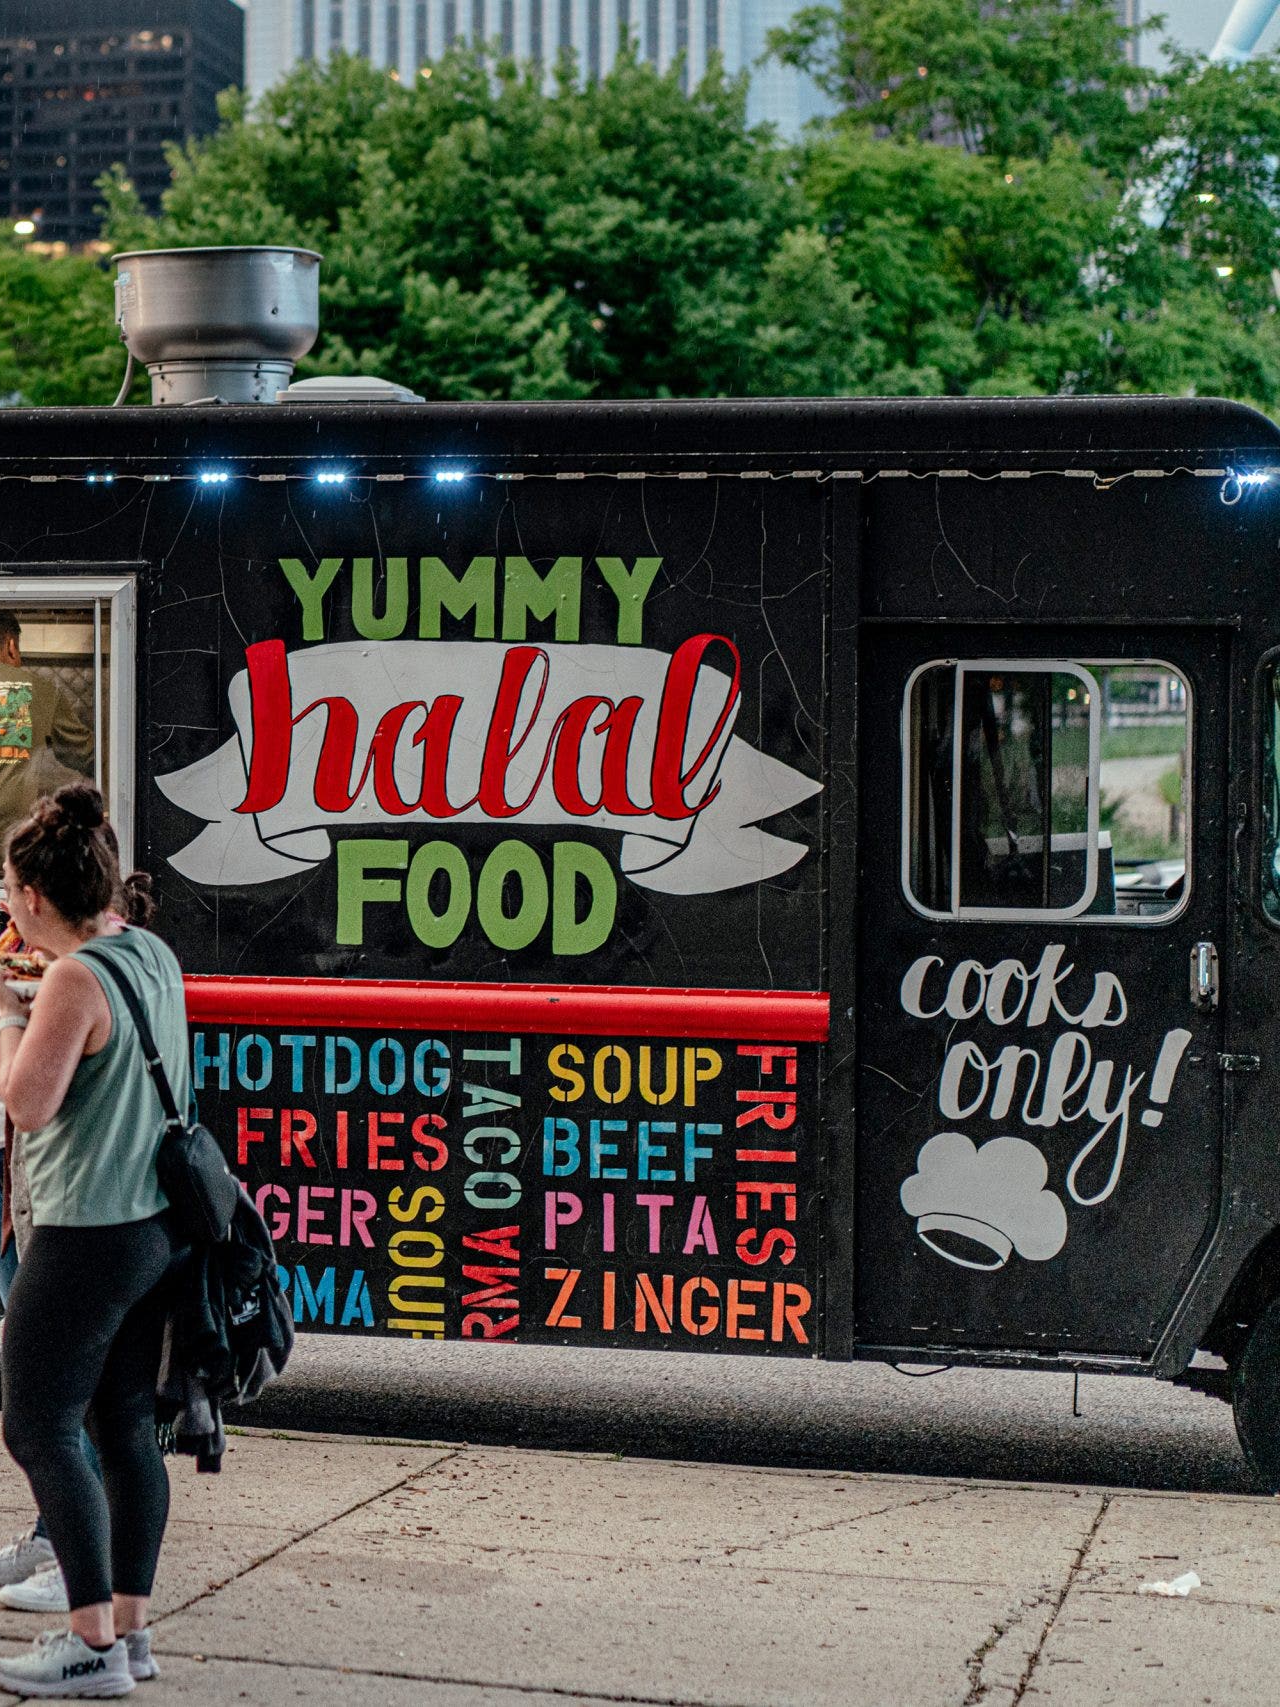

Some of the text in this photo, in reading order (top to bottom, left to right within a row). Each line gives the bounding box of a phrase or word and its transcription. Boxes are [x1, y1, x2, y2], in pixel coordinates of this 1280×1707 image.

[279, 557, 663, 644] YUMMY
[232, 633, 741, 819] halal
[336, 839, 616, 955] FOOD
[901, 944, 1128, 1028] cooks
[194, 1032, 451, 1097] HOTDOG
[547, 1044, 723, 1107] SOUP
[237, 1107, 449, 1172] FRIES
[462, 1038, 521, 1210] TACO
[543, 1117, 722, 1182] BEEF
[939, 1028, 1192, 1206] only!
[735, 1045, 798, 1266] FRIES
[239, 1182, 377, 1248] GER
[545, 1191, 719, 1255] PITA
[545, 1268, 812, 1344] ZINGER
[62, 1657, 106, 1680] HOKA
